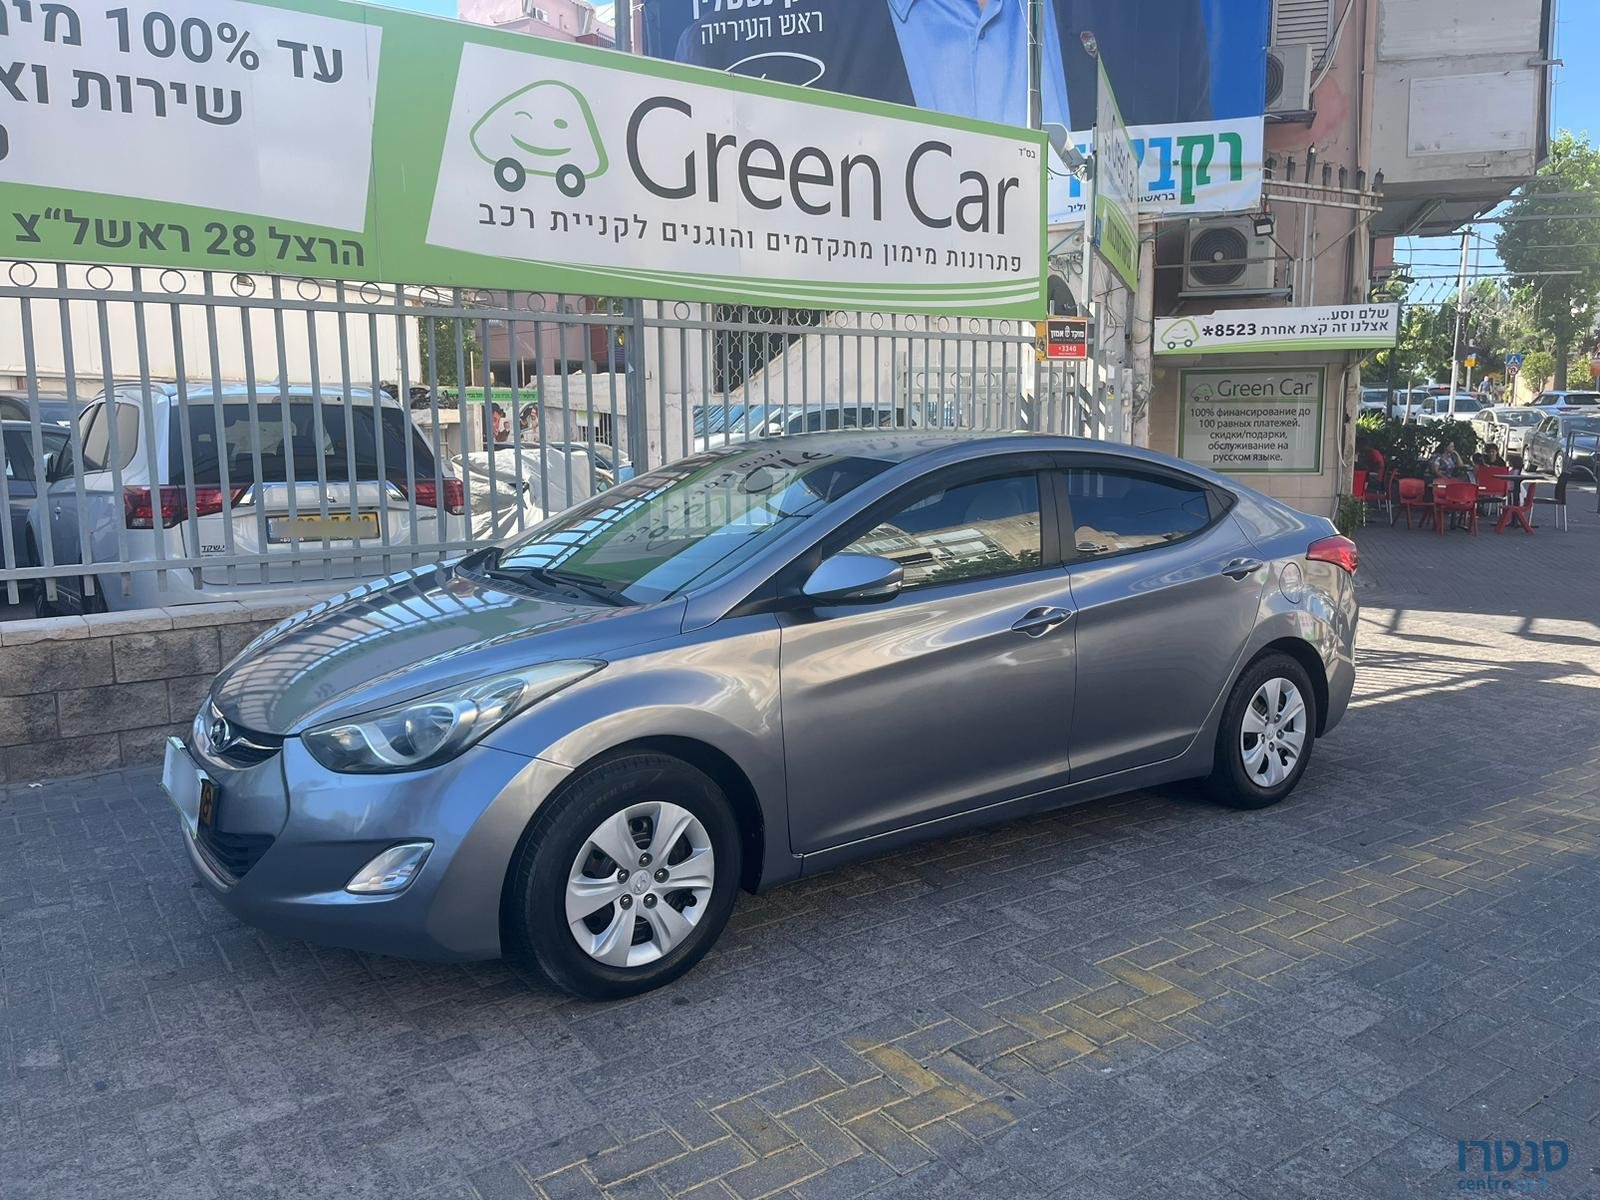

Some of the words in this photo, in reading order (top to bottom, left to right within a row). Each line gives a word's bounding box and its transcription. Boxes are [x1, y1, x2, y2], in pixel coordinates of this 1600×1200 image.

[0, 0, 82, 46] מי
[701, 16, 772, 45] העירייה
[779, 11, 823, 36] ראש
[106, 8, 260, 70] 100%
[277, 39, 344, 84] עד
[71, 69, 242, 125] שירות
[626, 96, 882, 221] Green
[905, 140, 1019, 235] Car
[479, 203, 535, 228] רכב
[550, 210, 648, 243] לקניית
[205, 221, 256, 258] 28
[268, 226, 365, 267] הרצל
[662, 222, 753, 249] והוגנים
[767, 232, 873, 262] מתקדמים
[883, 243, 937, 266] מימון
[946, 249, 1021, 272] פתרונות
[1359, 308, 1389, 319] שלם
[1260, 325, 1296, 336] אחרת
[1300, 324, 1327, 335] קצת
[1332, 322, 1347, 333] זה
[1351, 320, 1389, 332] אצלנו
[1217, 380, 1274, 397] Green
[1280, 378, 1313, 395] Car
[1191, 408, 1214, 417] 100%
[1216, 407, 1297, 419] финансирование
[1298, 409, 1311, 418] до
[1200, 419, 1215, 428] 100
[1217, 420, 1251, 430] равных
[1208, 442, 1276, 452] обслуживание
[1277, 442, 1289, 450] на
[1210, 430, 1288, 440] скидки/подарки,
[1213, 453, 1251, 463] русском
[1252, 453, 1283, 462] языке.
